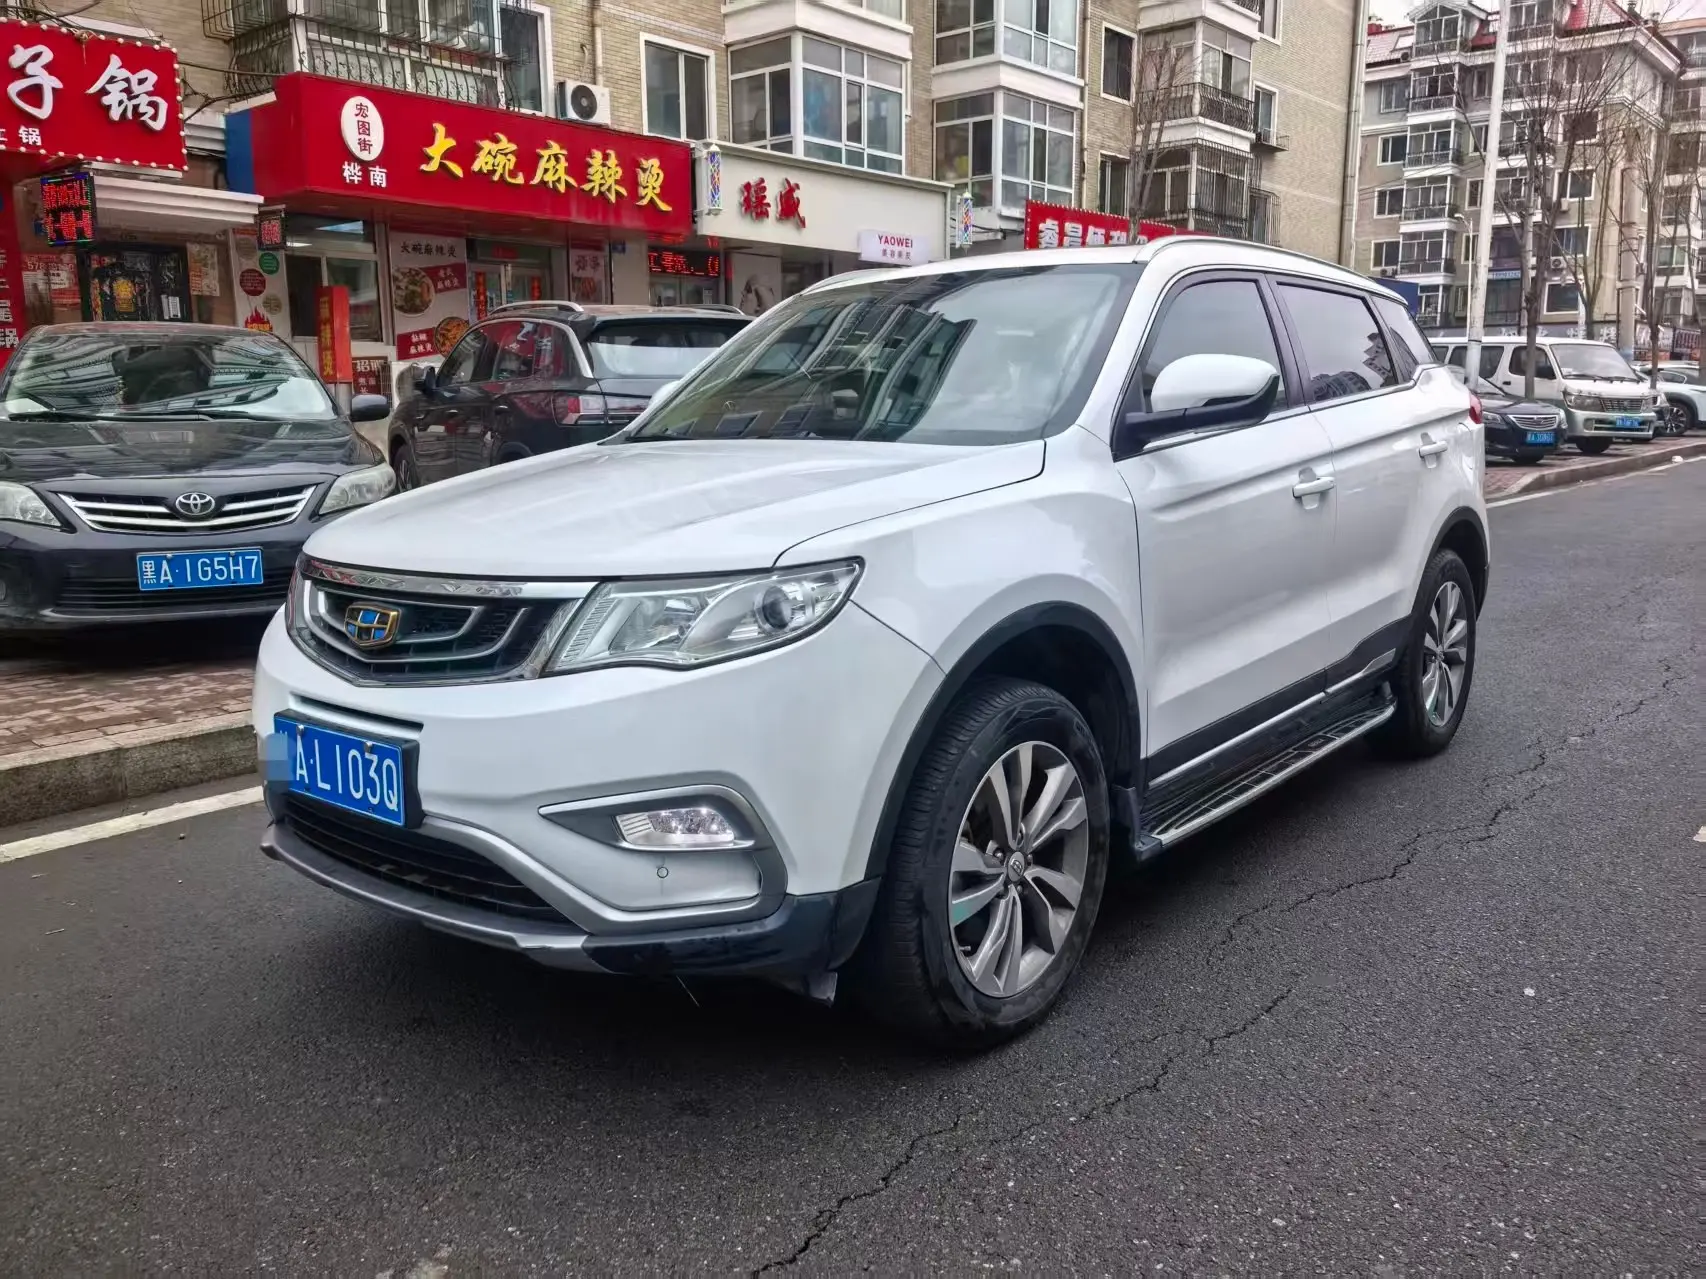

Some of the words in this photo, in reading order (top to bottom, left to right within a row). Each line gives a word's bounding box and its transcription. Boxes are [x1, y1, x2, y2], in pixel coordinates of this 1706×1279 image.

[7, 44, 169, 132] 子锅
[354, 102, 374, 155] 宏图街
[342, 160, 388, 188] 桦南
[420, 122, 673, 211] 大碗麻辣烫
[741, 177, 806, 229] 瑶威
[400, 241, 458, 258] 大碗麻辣烫
[877, 234, 914, 248] YAOWEI
